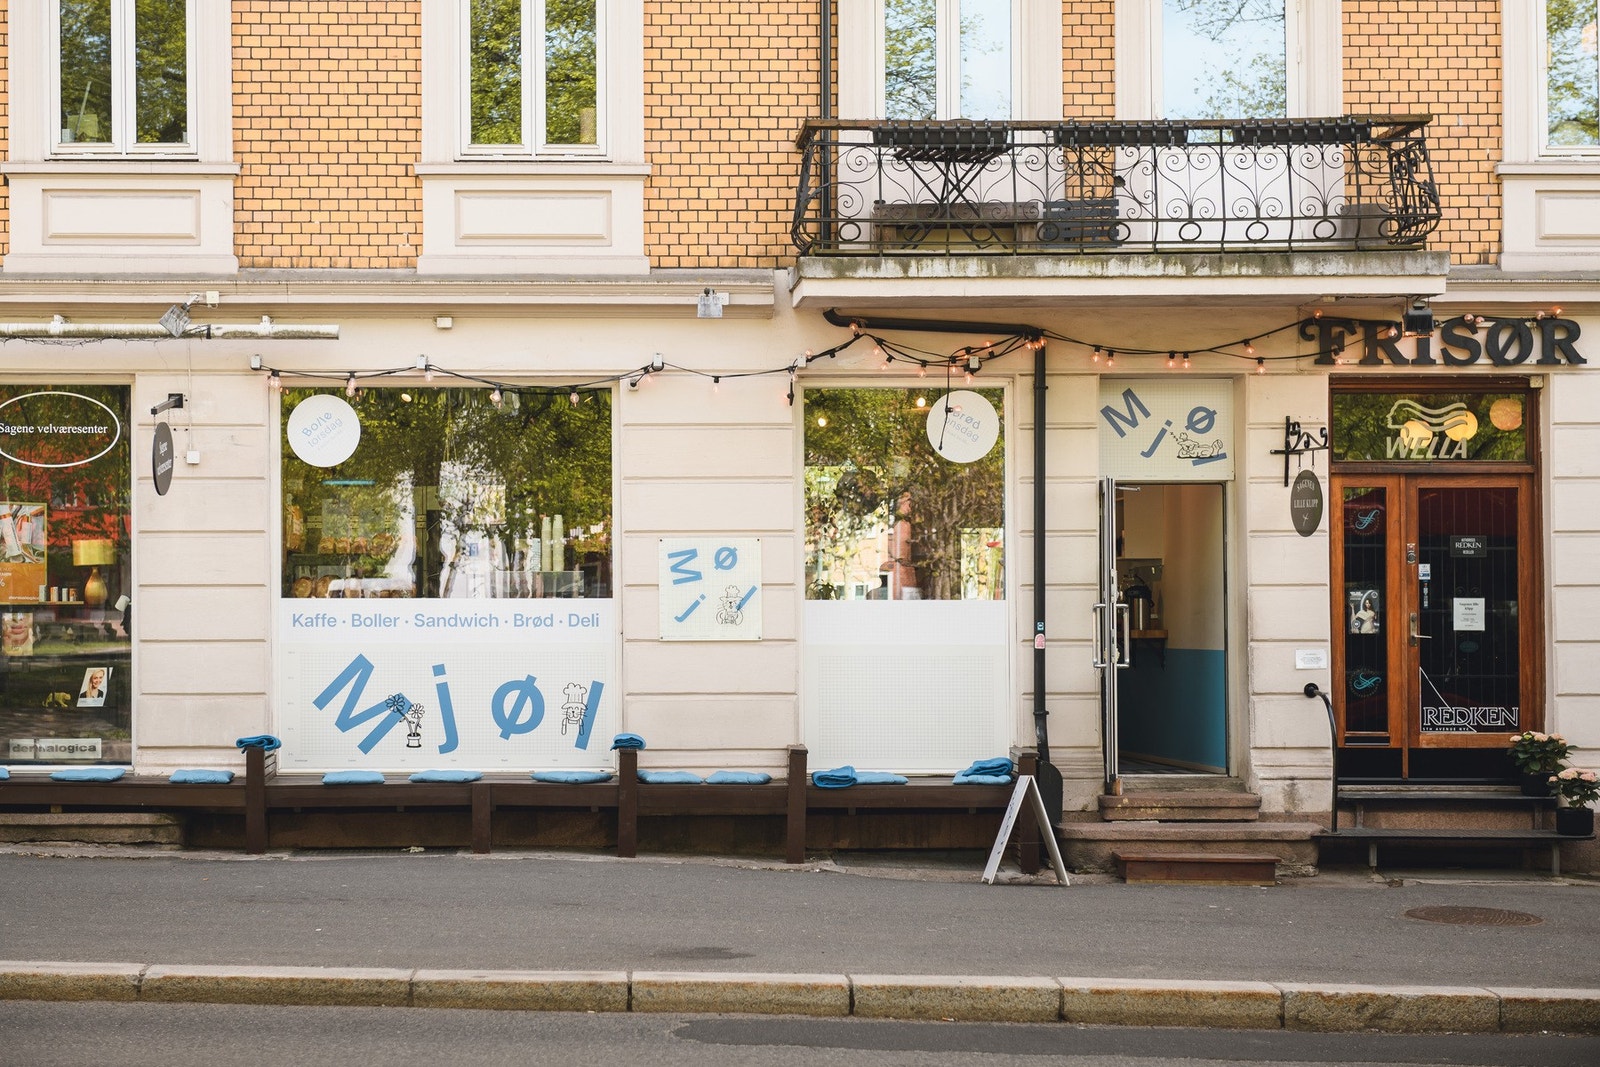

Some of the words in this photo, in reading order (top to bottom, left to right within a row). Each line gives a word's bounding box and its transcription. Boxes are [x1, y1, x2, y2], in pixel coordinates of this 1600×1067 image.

[1300, 317, 1588, 367] FRISØR
[0, 423, 35, 436] Sagene
[37, 423, 108, 434] velværesenter
[301, 411, 333, 437] Bolle
[1386, 436, 1468, 459] WELLA
[292, 613, 337, 628] Kaffe
[351, 613, 400, 628] Boller
[414, 613, 500, 628] Sandwich
[513, 613, 554, 628] Brød
[568, 613, 600, 628] Deli
[1422, 706, 1519, 727] REDKEN
